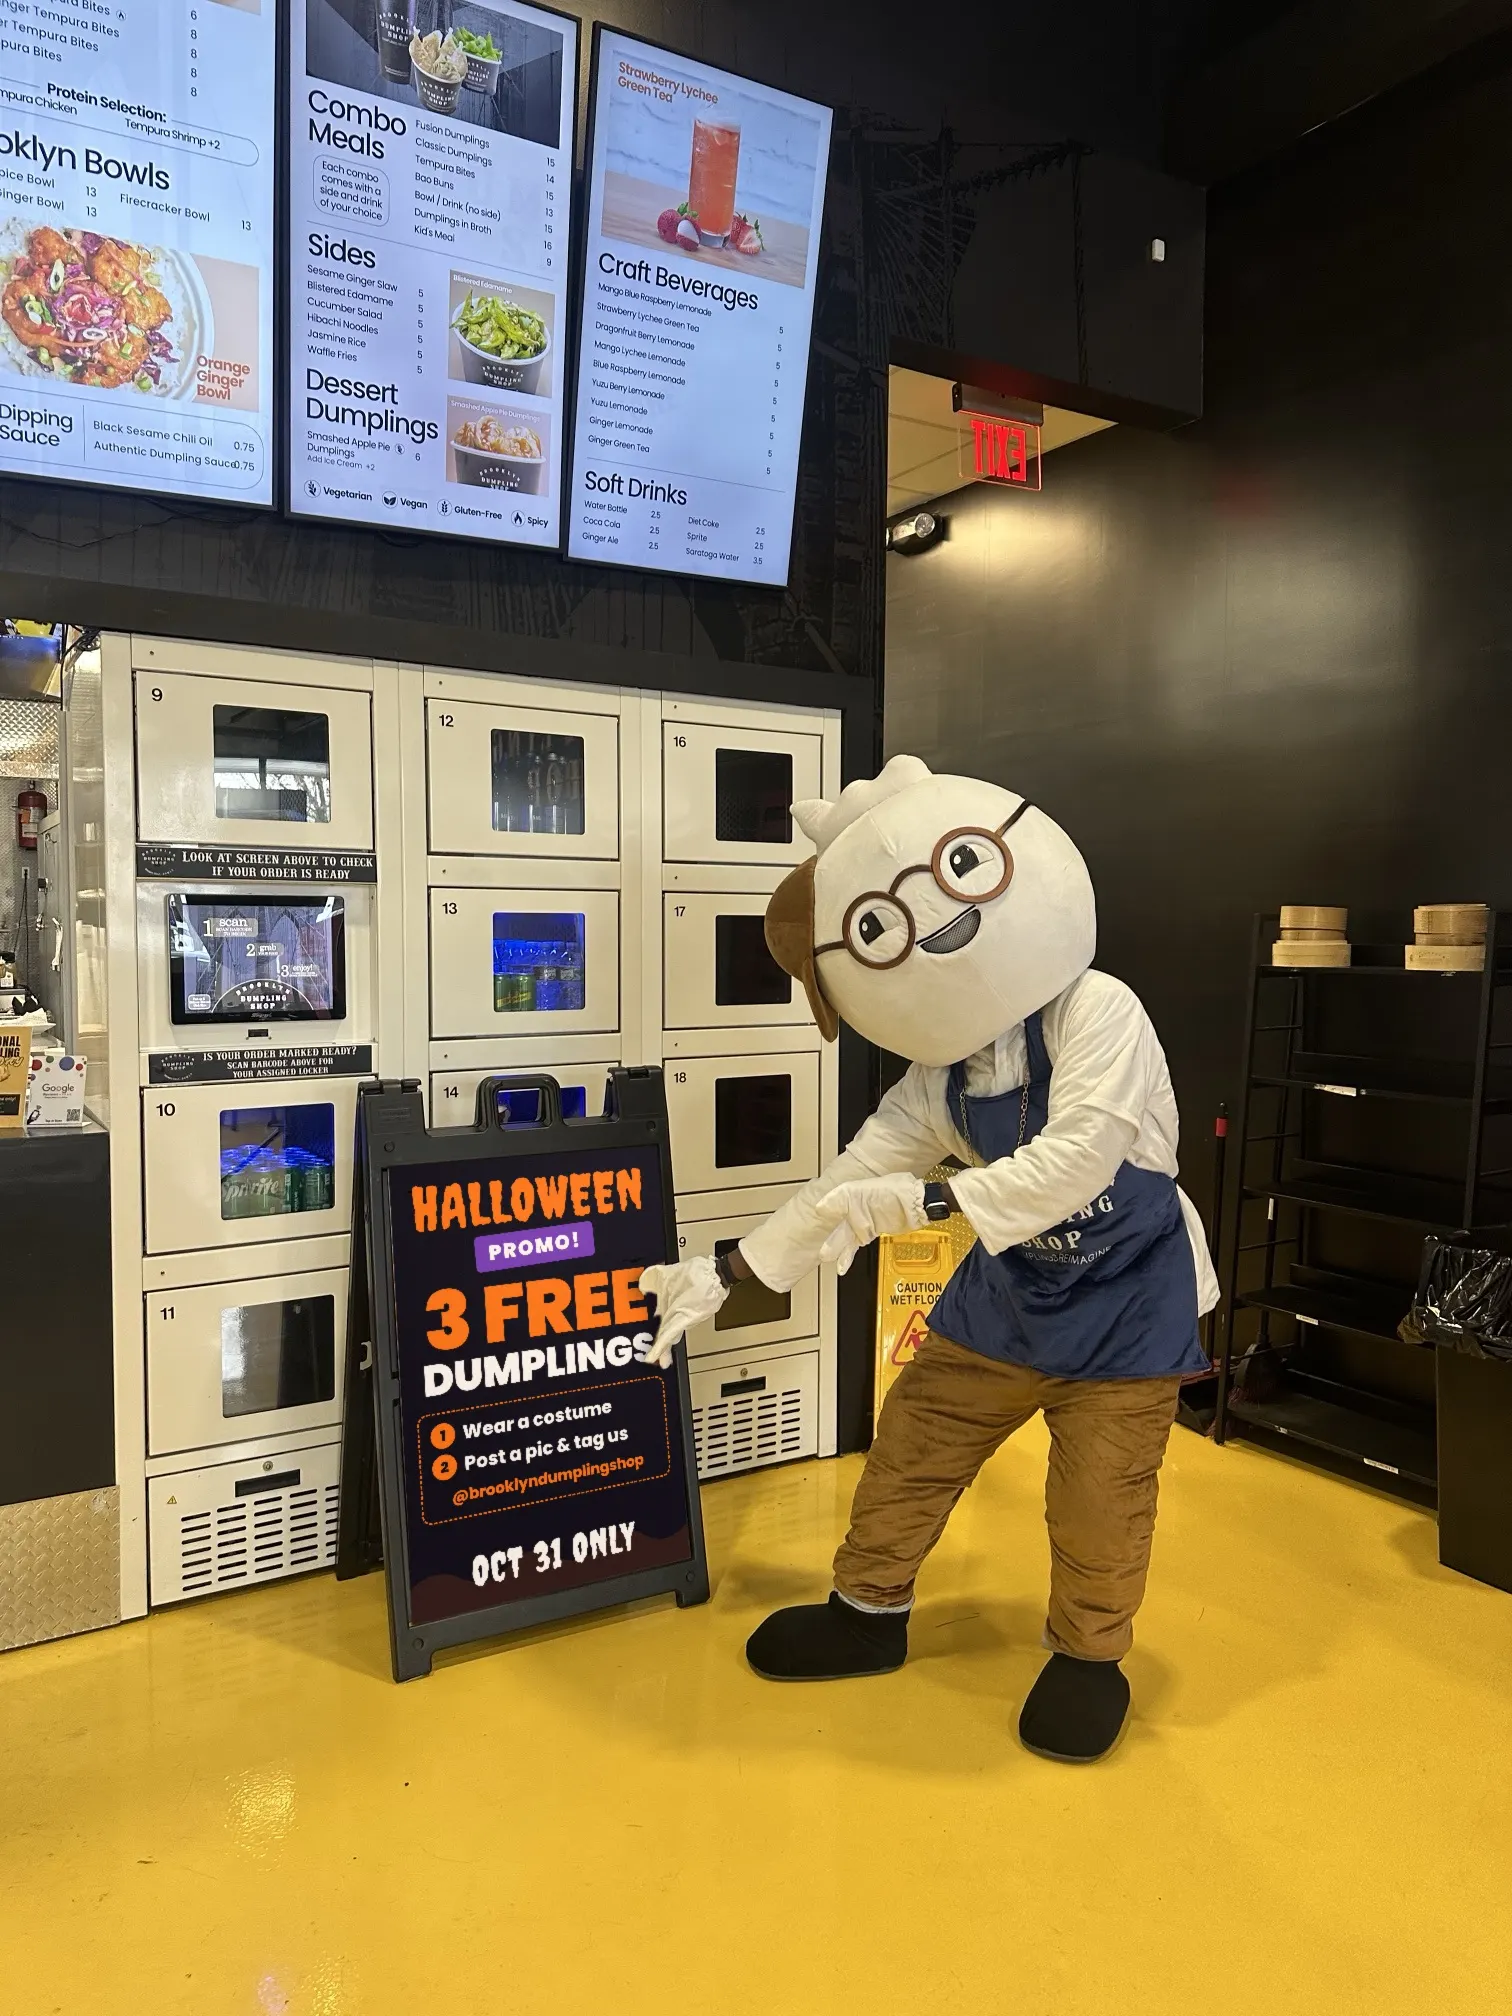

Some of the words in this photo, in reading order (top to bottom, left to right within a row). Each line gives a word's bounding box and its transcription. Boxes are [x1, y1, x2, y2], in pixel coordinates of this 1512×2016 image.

[33, 6, 88, 29] Tempura
[92, 22, 120, 38] Bites
[618, 76, 651, 96] Green
[653, 88, 673, 103] Tea
[619, 61, 680, 95] Strawberry
[681, 83, 718, 104] Lychee
[48, 83, 98, 105] Protein
[100, 96, 167, 122] Selection:
[308, 89, 406, 136] Combo
[125, 118, 170, 138] Tempura
[172, 130, 207, 147] Shrimp
[208, 139, 220, 150] +2
[309, 118, 384, 160] Meals
[416, 120, 443, 135] Fusion
[445, 127, 490, 149] Dumplings
[416, 138, 446, 153] Classic
[447, 146, 493, 167] Dumplings
[546, 157, 555, 167] 15
[86, 148, 170, 190] Bowls
[416, 155, 455, 174] Tempura
[456, 166, 476, 179] Bites
[415, 173, 432, 186] Bao
[433, 177, 454, 191] Buns
[120, 193, 182, 215] Firecracker
[185, 208, 210, 222] Bowl
[242, 220, 251, 231] 13
[414, 225, 433, 238] Kid's
[435, 229, 455, 243] Meal
[308, 233, 376, 270] Sides
[307, 265, 345, 279] Sesame
[346, 273, 376, 289] Ginger
[377, 279, 398, 292] Slaw
[599, 252, 651, 284] Craft
[656, 265, 758, 310] Beverages
[307, 281, 346, 297] Blistered
[347, 289, 394, 307] Edamame
[307, 297, 356, 314] Cucumber
[358, 306, 383, 320] Salad
[597, 302, 637, 320] Strawberry
[638, 311, 663, 325] Lychee
[664, 316, 686, 330] Green
[687, 322, 700, 333] Tea
[307, 312, 342, 329] Hibachi
[343, 319, 379, 335] Noodles
[307, 328, 346, 344] Jasmine
[348, 336, 366, 348] Rice
[307, 345, 336, 359] Waffle
[337, 349, 358, 362] Fries
[196, 355, 250, 375] Orange
[196, 370, 244, 389] Ginger
[306, 367, 399, 405] Dessert
[196, 384, 230, 400] Bowl
[590, 397, 608, 409] Yuzu
[609, 400, 648, 416] Lemonade
[0, 403, 73, 433] Dipping
[306, 396, 439, 444] Dumplings
[589, 416, 614, 430] Ginger
[615, 419, 653, 435] Lemonade
[0, 425, 60, 447] Sauce
[93, 420, 124, 434] Black
[126, 426, 170, 441] Sesame
[173, 432, 197, 445] Chili
[199, 436, 213, 447] Oil
[234, 441, 255, 453] 0.75
[584, 470, 624, 496] Soft
[628, 477, 688, 506] Drinks
[323, 486, 373, 502] Vegetarian
[400, 497, 428, 510] Vegan
[454, 505, 503, 520] Gluten-Free
[527, 516, 548, 528] Spicy
[584, 500, 606, 511] Water
[607, 504, 628, 514] Bottle
[583, 516, 603, 527] Coca
[604, 519, 621, 529] Cola
[703, 518, 719, 529] Coke
[687, 532, 707, 543] Sprite
[151, 687, 163, 702] 9
[439, 714, 454, 727] 12
[673, 736, 686, 748] 16
[182, 851, 213, 863] LOOK
[217, 853, 232, 864] AT
[236, 853, 279, 865] SCREEN
[283, 854, 319, 866] ABOVE
[322, 856, 337, 867] TO
[340, 857, 373, 867] CHECK
[212, 866, 224, 876] IF
[229, 867, 257, 877] YOUR
[260, 868, 298, 878] ORDER
[301, 868, 311, 878] IS
[315, 869, 350, 880] READY
[442, 902, 458, 915] 13
[674, 906, 686, 917] 17
[203, 920, 213, 936] 1
[219, 918, 248, 927] scan
[246, 944, 256, 957] 2
[259, 944, 277, 952] grab
[280, 965, 289, 977] 3
[293, 964, 314, 973] enjoy!
[241, 994, 287, 1002] DUMPLING
[203, 1052, 213, 1061] IS
[216, 1050, 241, 1061] YOUR
[244, 1049, 274, 1060] ORDER
[279, 1048, 319, 1058] MARKED
[322, 1046, 357, 1056] READY?
[227, 1060, 249, 1069] SCAN
[251, 1059, 288, 1069] BARCODE
[290, 1058, 316, 1067] ABOVE
[319, 1056, 334, 1066] FOR
[232, 1069, 254, 1079] YOUR
[256, 1067, 296, 1077] ASSIGNED
[299, 1066, 329, 1075] LOCKER
[674, 1072, 687, 1083] 18
[42, 1083, 75, 1093] Google
[443, 1086, 459, 1098] 14
[156, 1103, 176, 1117] 10
[411, 1167, 642, 1233] HALLOWEEN
[488, 1232, 579, 1261] PROMO!
[897, 1282, 942, 1292] CAUTION
[426, 1287, 470, 1350] 3
[483, 1266, 649, 1344] FREE
[890, 1295, 912, 1305] WET
[160, 1306, 175, 1320] 11
[423, 1333, 654, 1398] DUMPLINGS
[463, 1418, 515, 1440] Wear
[517, 1417, 530, 1430] a
[532, 1402, 613, 1428] costume
[464, 1449, 507, 1471] Post
[510, 1447, 521, 1462] a
[525, 1441, 553, 1464] pic
[556, 1438, 570, 1452] &
[573, 1433, 606, 1451] tag
[608, 1428, 629, 1442] us
[452, 1454, 644, 1506] @brooklyndumplingshop
[472, 1546, 524, 1587] OCT
[533, 1537, 563, 1573] 31
[572, 1521, 636, 1564] ONLY
